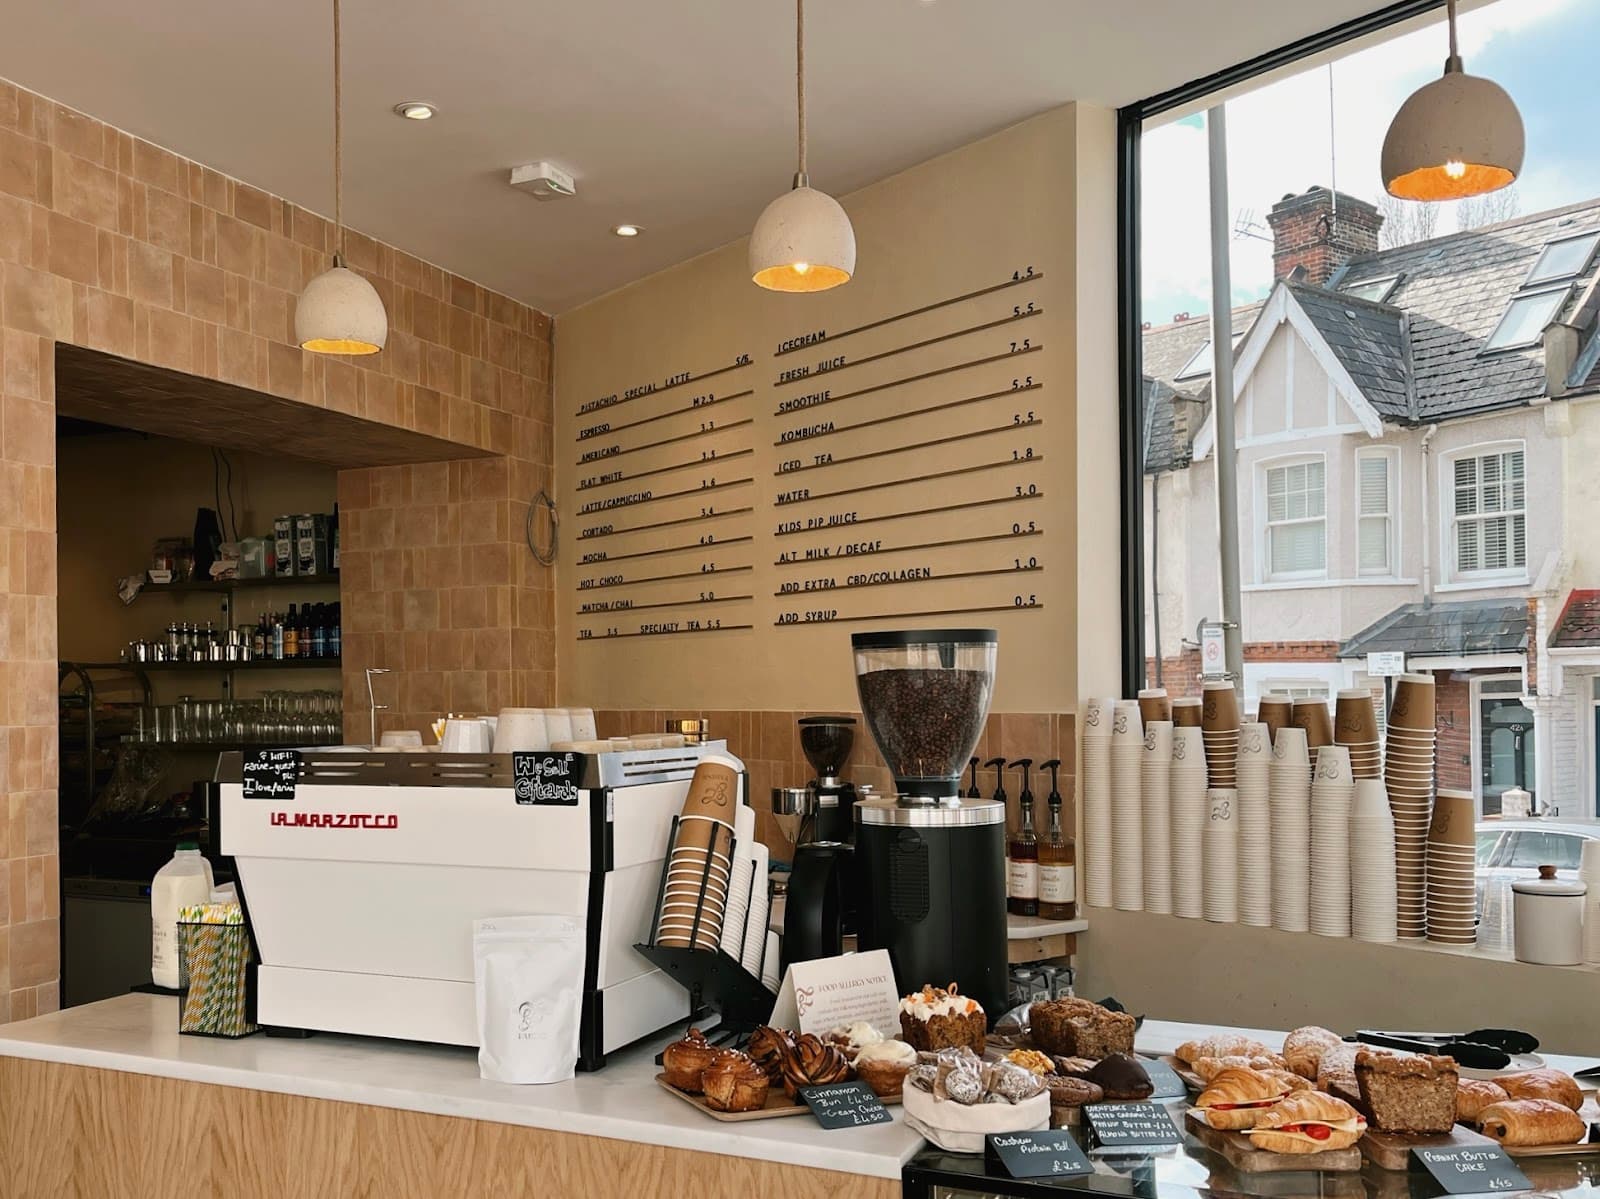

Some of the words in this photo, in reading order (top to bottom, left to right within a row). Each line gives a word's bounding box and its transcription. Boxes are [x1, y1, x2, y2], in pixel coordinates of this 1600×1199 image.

[778, 330, 826, 353] ICECREAM
[1012, 267, 1033, 282] 4.5
[780, 366, 809, 383] FRESH
[816, 356, 846, 372] JUICE
[1014, 303, 1034, 317] 5.5
[779, 391, 831, 412] SMOOTHIE
[1010, 340, 1030, 352] 7.5
[581, 395, 618, 412] PISTACHIO
[624, 384, 656, 400] SPECIAL
[665, 372, 690, 386] LATTE
[781, 422, 834, 442] KOMBUCHA
[1012, 376, 1032, 390] 5.5
[580, 423, 610, 438] ESPRESSO
[581, 446, 620, 462] AMERICANO
[701, 421, 714, 432] 3.3
[779, 460, 801, 473] ICED
[814, 454, 832, 465] TEA
[1014, 412, 1034, 425] 5.5
[580, 478, 596, 488] FLAT
[600, 472, 623, 484] WHITE
[778, 489, 810, 503] WATER
[1012, 448, 1033, 460] 1.8
[582, 525, 614, 537] CORTADO
[702, 507, 714, 516] 3.4
[778, 521, 802, 534] KIDS
[808, 517, 824, 530] PIP
[828, 512, 857, 526] JUICE
[1016, 484, 1036, 496] 3.0
[584, 552, 608, 562] MOCHA
[701, 536, 714, 544] 4.0
[780, 552, 796, 562] ALT
[806, 548, 830, 560] MILK
[846, 541, 882, 554] DECAF
[1012, 522, 1035, 534] 0.5
[580, 580, 594, 588] HOT
[600, 576, 624, 586] CHOCO
[702, 564, 714, 572] 4.5
[780, 582, 799, 594] ADD
[805, 578, 836, 591] EXTRA
[847, 567, 930, 586] CBD/COLLAGEN
[1014, 557, 1036, 570] 1.0
[700, 592, 714, 600] 5.0
[778, 613, 798, 624] ADD
[805, 610, 838, 622] SYRUP
[1015, 595, 1036, 606] 0.5
[580, 630, 592, 638] TEA
[640, 623, 678, 633] SPECIALTY
[688, 621, 700, 631] TEA
[708, 620, 720, 629] 5.5
[515, 756, 542, 776] We
[543, 757, 570, 776] Sell
[818, 983, 838, 992] FOOD
[838, 979, 864, 990] ALLERGY
[866, 976, 888, 985] NOTICE
[804, 1087, 860, 1098] Cinnamon
[816, 1098, 841, 1107] Bun
[1122, 1120, 1152, 1129] BUTTER
[1456, 1163, 1486, 1172] CAKE
